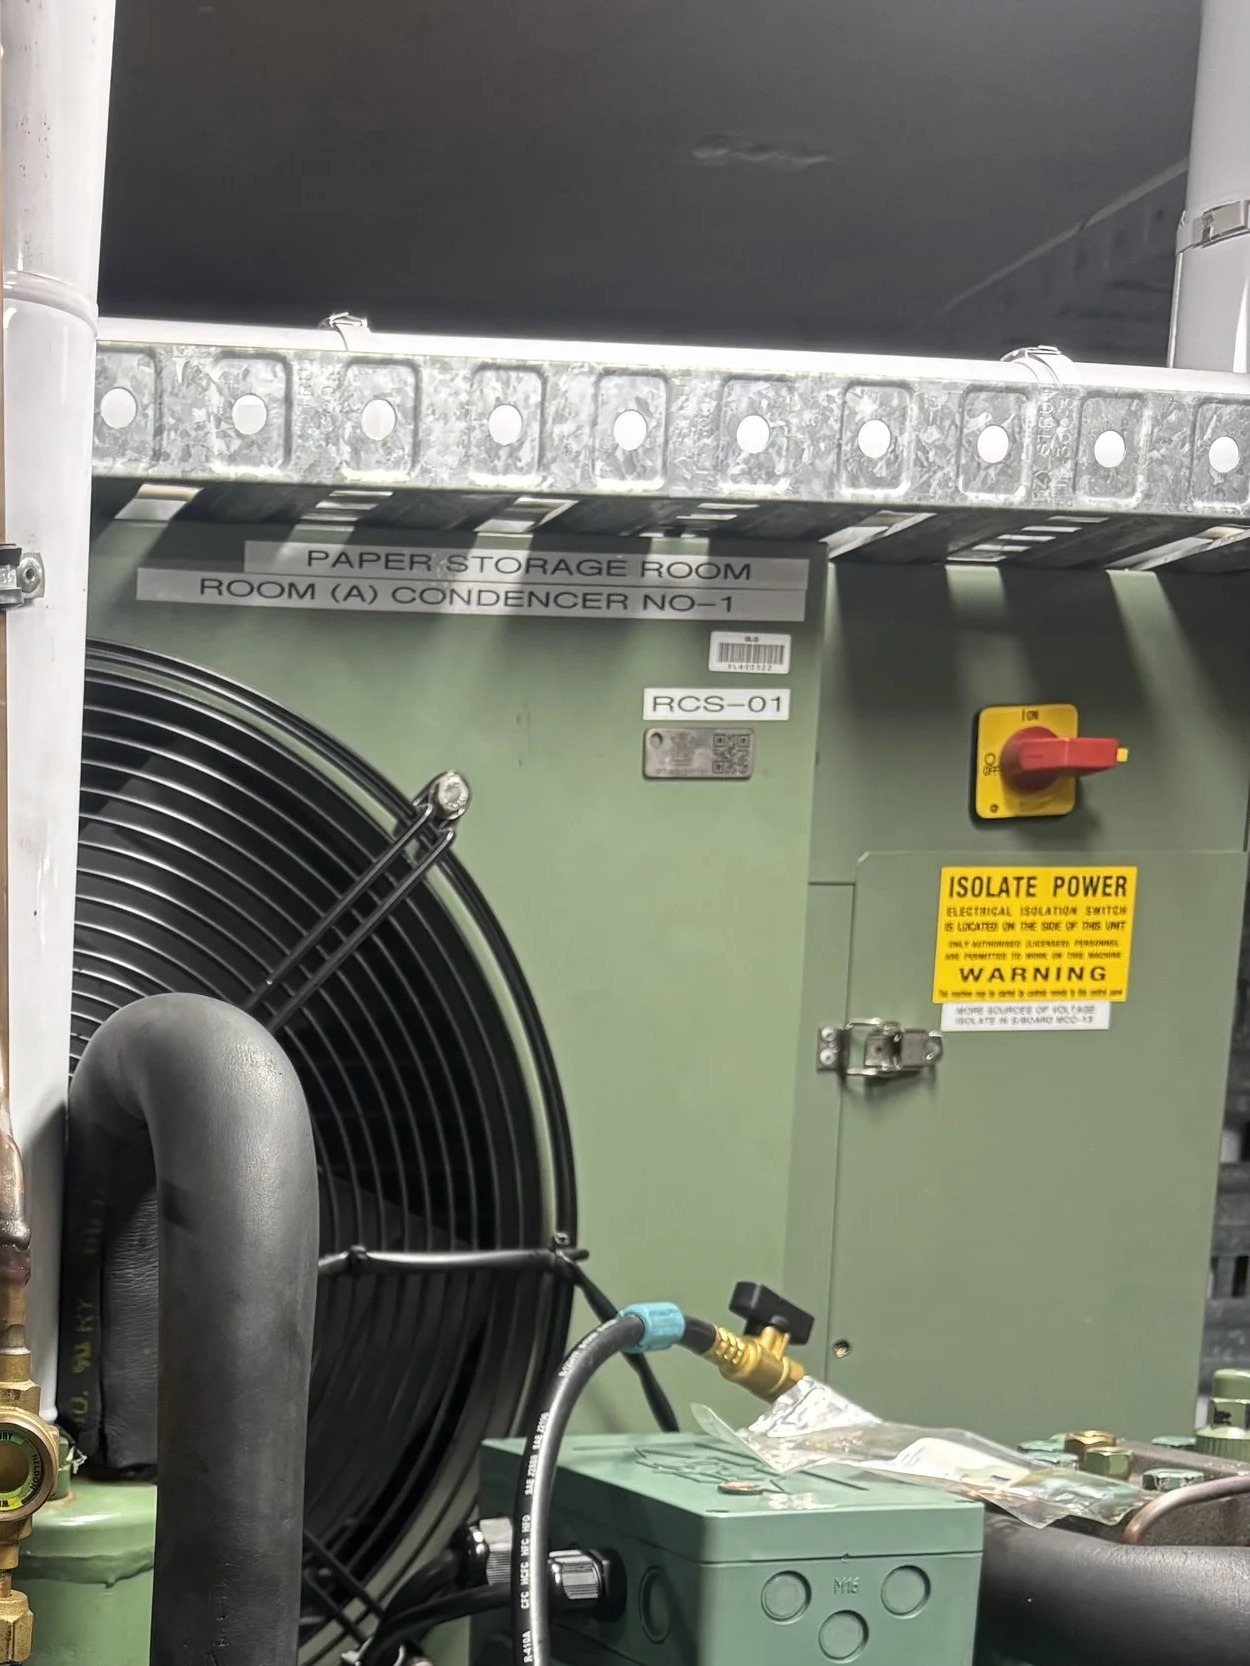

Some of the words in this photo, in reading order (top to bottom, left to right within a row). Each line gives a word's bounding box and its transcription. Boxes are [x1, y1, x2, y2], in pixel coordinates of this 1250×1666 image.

[308, 549, 432, 574] PAPER
[444, 554, 627, 578] STORAGE
[640, 558, 751, 582] ROOM
[199, 577, 316, 601] ROOM
[331, 580, 379, 605] (A)
[391, 585, 629, 611] CONDENCER
[643, 592, 734, 613] NO-1
[652, 695, 781, 712] RCS-01
[948, 876, 1037, 898] ISOLATE
[1053, 875, 1127, 898] POWER
[946, 906, 1011, 917] ELECTRICAL
[1020, 906, 1078, 917] ISOLATION
[1085, 906, 1127, 916] SWITCH
[957, 922, 998, 932] LOCATED
[1020, 922, 1036, 931] THE
[1041, 922, 1061, 931] SIDE
[1065, 922, 1078, 931] OF
[1082, 922, 1101, 930] THIS
[1105, 921, 1126, 930] UNIT
[958, 966, 1107, 983] WARNING
[521, 1514, 531, 1533] HFO
[520, 1538, 530, 1557] HFC
[520, 1591, 530, 1609] CFC
[522, 1630, 533, 1663] R-410A
